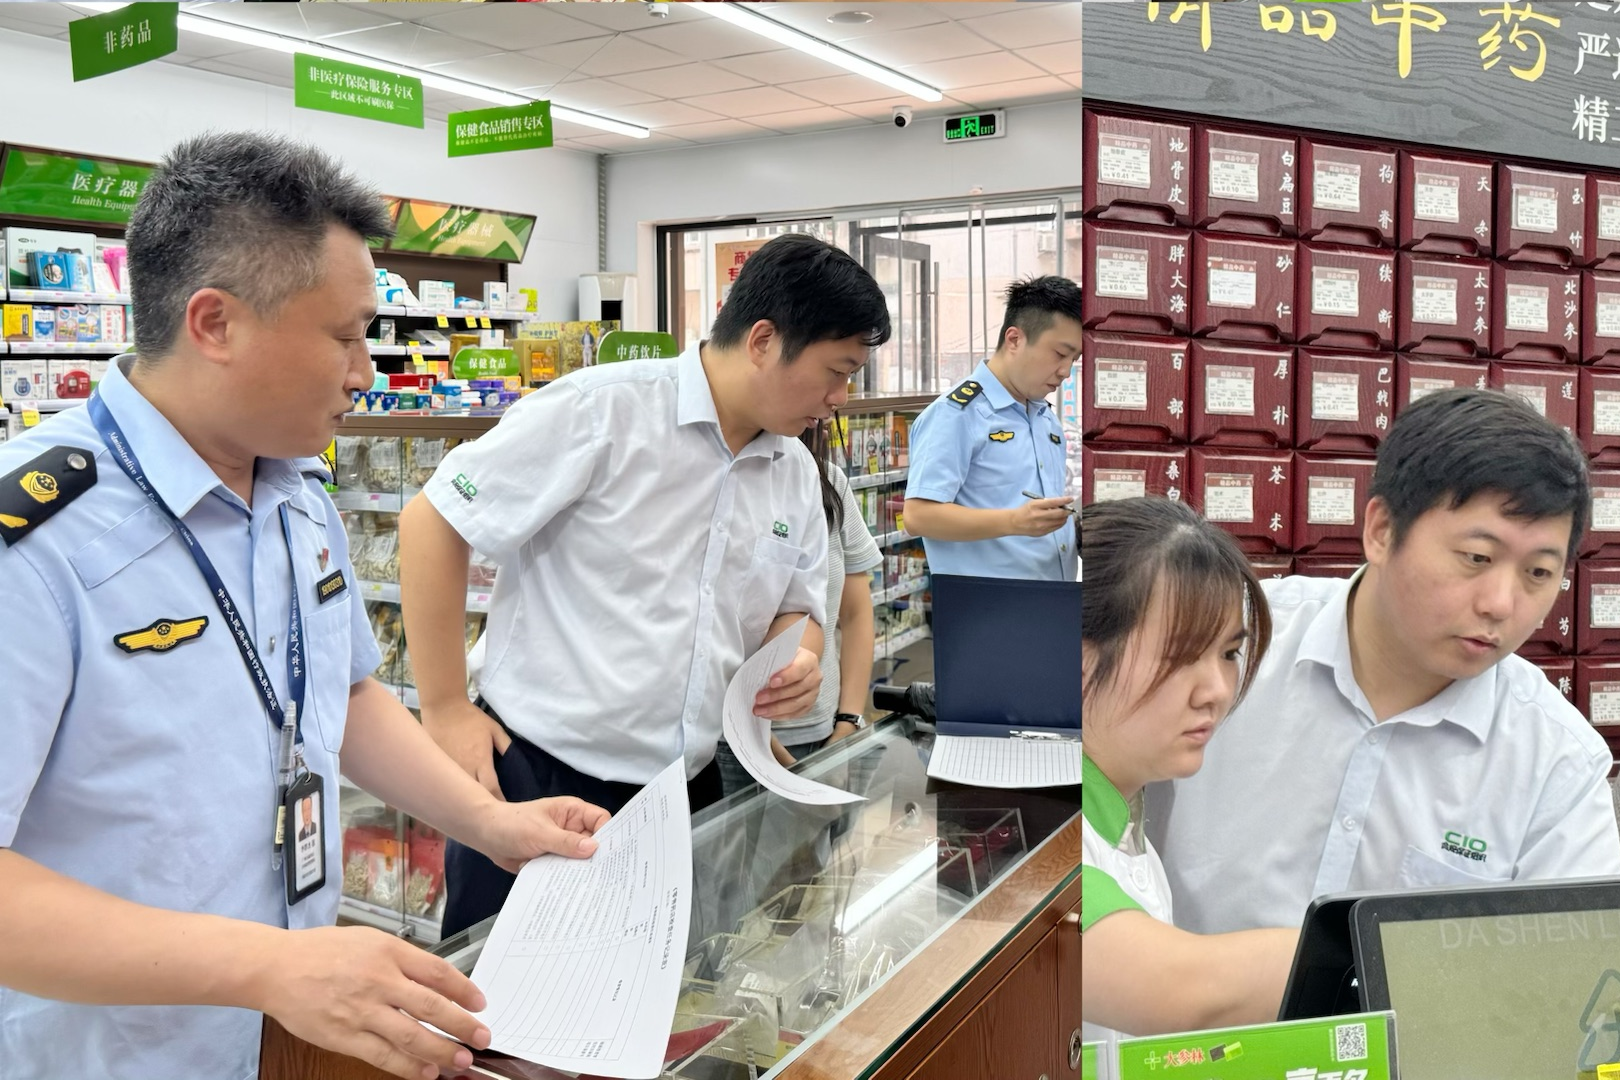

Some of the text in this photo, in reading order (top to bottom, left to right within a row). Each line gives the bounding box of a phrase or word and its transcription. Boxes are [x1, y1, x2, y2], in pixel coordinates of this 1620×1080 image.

[102, 19, 153, 56] 非药品
[307, 66, 413, 101] 非医疗保险服务专区
[330, 90, 395, 111] 此区域不可刷医保
[455, 114, 545, 139] 保健食品销售专区
[981, 124, 994, 135] EXIT
[71, 172, 146, 200] 医疗器
[1167, 137, 1189, 206] 地骨皮
[1278, 150, 1295, 215] 白扁豆
[71, 194, 103, 208] Health
[1474, 176, 1491, 238] 天冬
[1569, 187, 1584, 249] 玉竹
[437, 217, 495, 239] 医疗器械
[1168, 244, 1188, 314] 胖大海
[1275, 254, 1293, 317] 砂仁
[1377, 263, 1393, 329] 续断
[1473, 271, 1489, 335] 太子参
[1563, 279, 1578, 341] 北沙参
[469, 357, 507, 370] 保健食品
[616, 343, 662, 361] 中药饮片
[1166, 352, 1186, 420] 百部
[1272, 359, 1289, 426] 厚朴
[134, 474, 149, 493] Law
[1444, 830, 1488, 853] CIO
[1439, 919, 1490, 950] DA
[1495, 916, 1590, 947] SHEN
